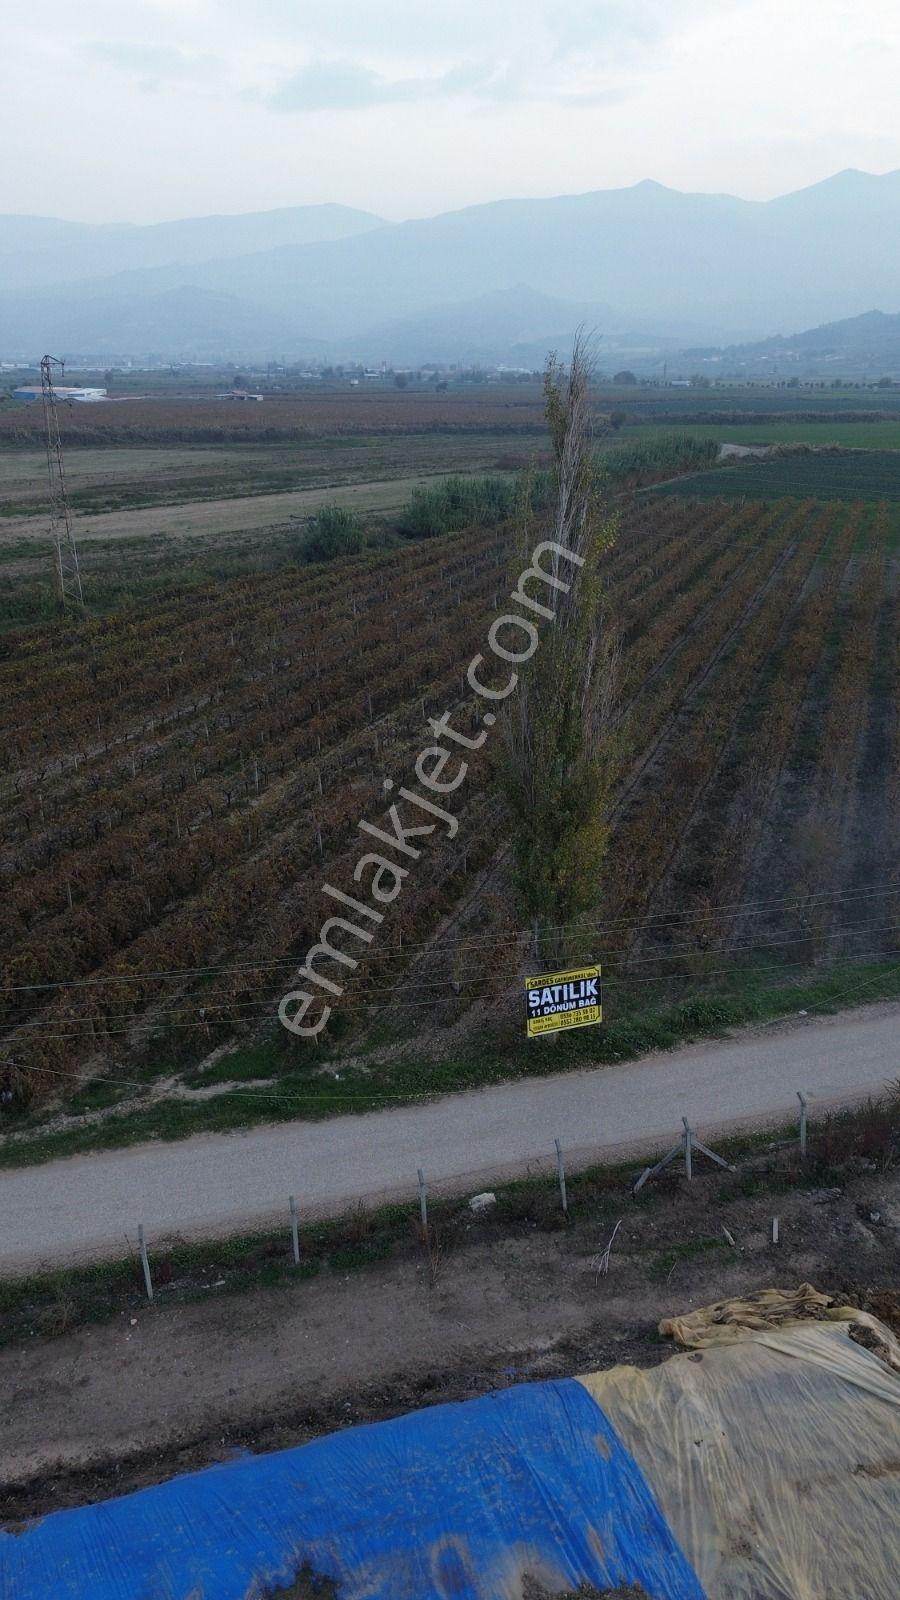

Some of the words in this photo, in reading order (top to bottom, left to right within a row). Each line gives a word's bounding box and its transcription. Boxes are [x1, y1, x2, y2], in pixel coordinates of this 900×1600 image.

[528, 978, 599, 1008] SATILIK
[531, 1009, 541, 1017] 11
[543, 1001, 577, 1015] DÖNÜM
[578, 996, 597, 1008] BAĞ
